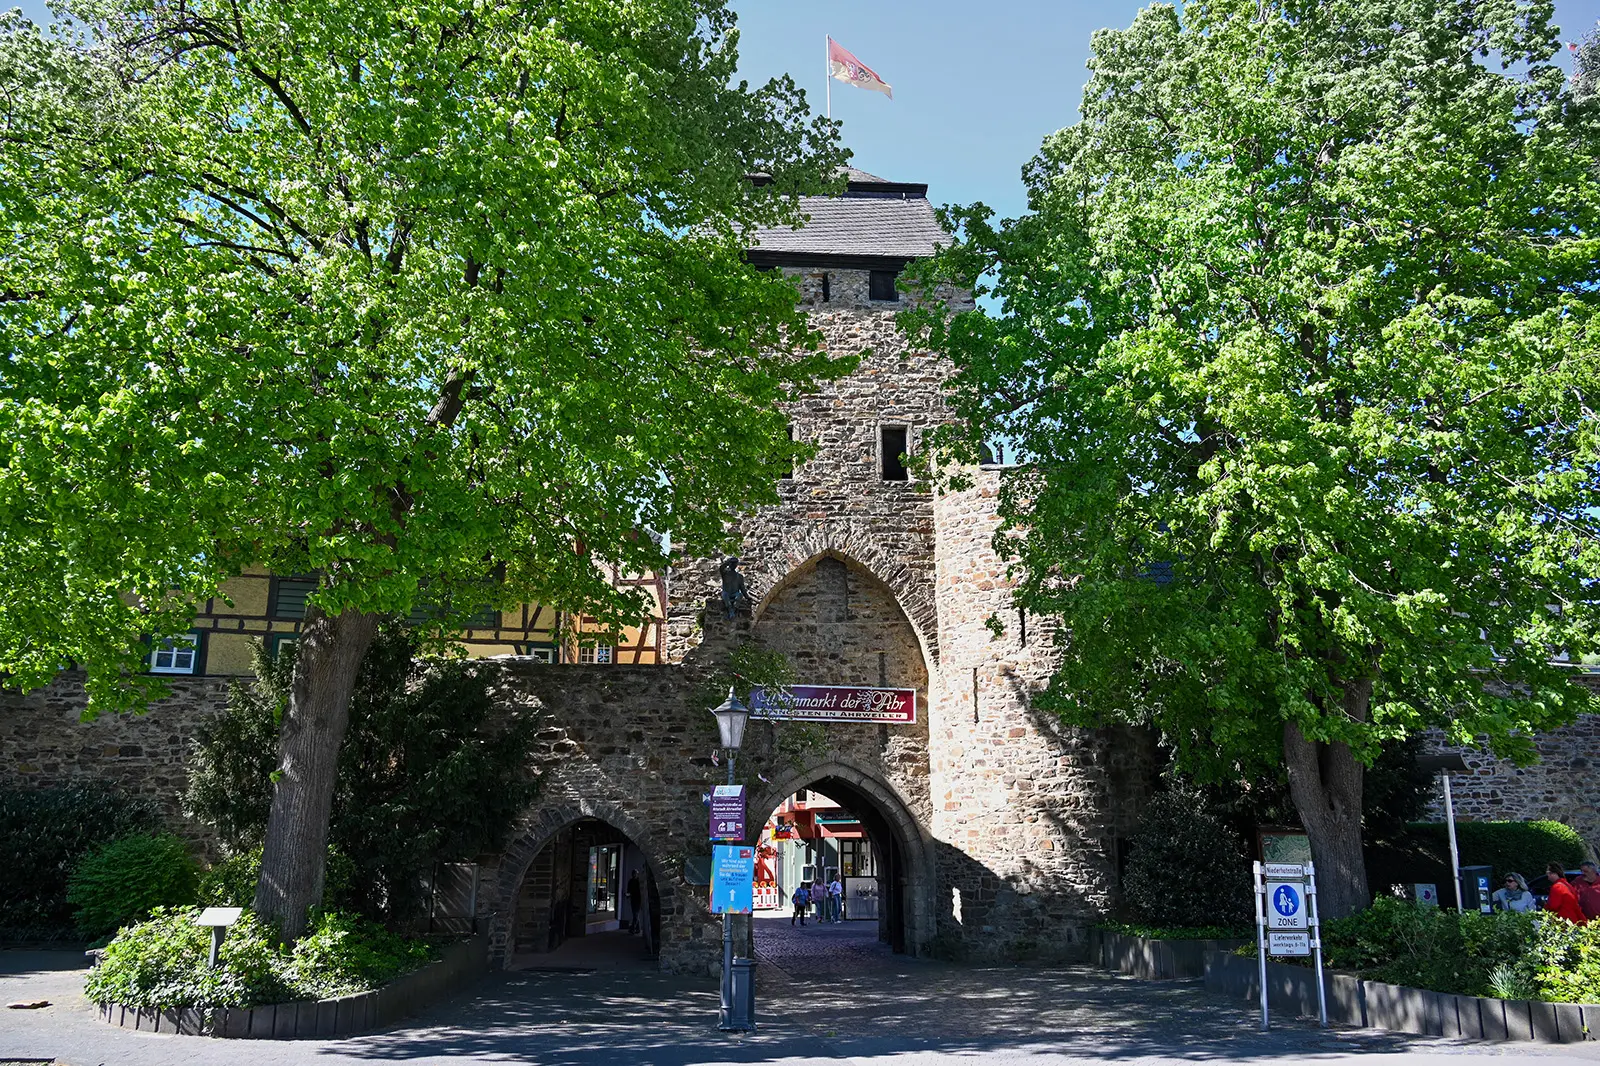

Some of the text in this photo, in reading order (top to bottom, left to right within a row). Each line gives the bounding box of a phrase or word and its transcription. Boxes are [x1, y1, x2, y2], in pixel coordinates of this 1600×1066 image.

[840, 693, 861, 708] der
[872, 691, 906, 711] Ahr
[1277, 918, 1298, 926] ZONE
